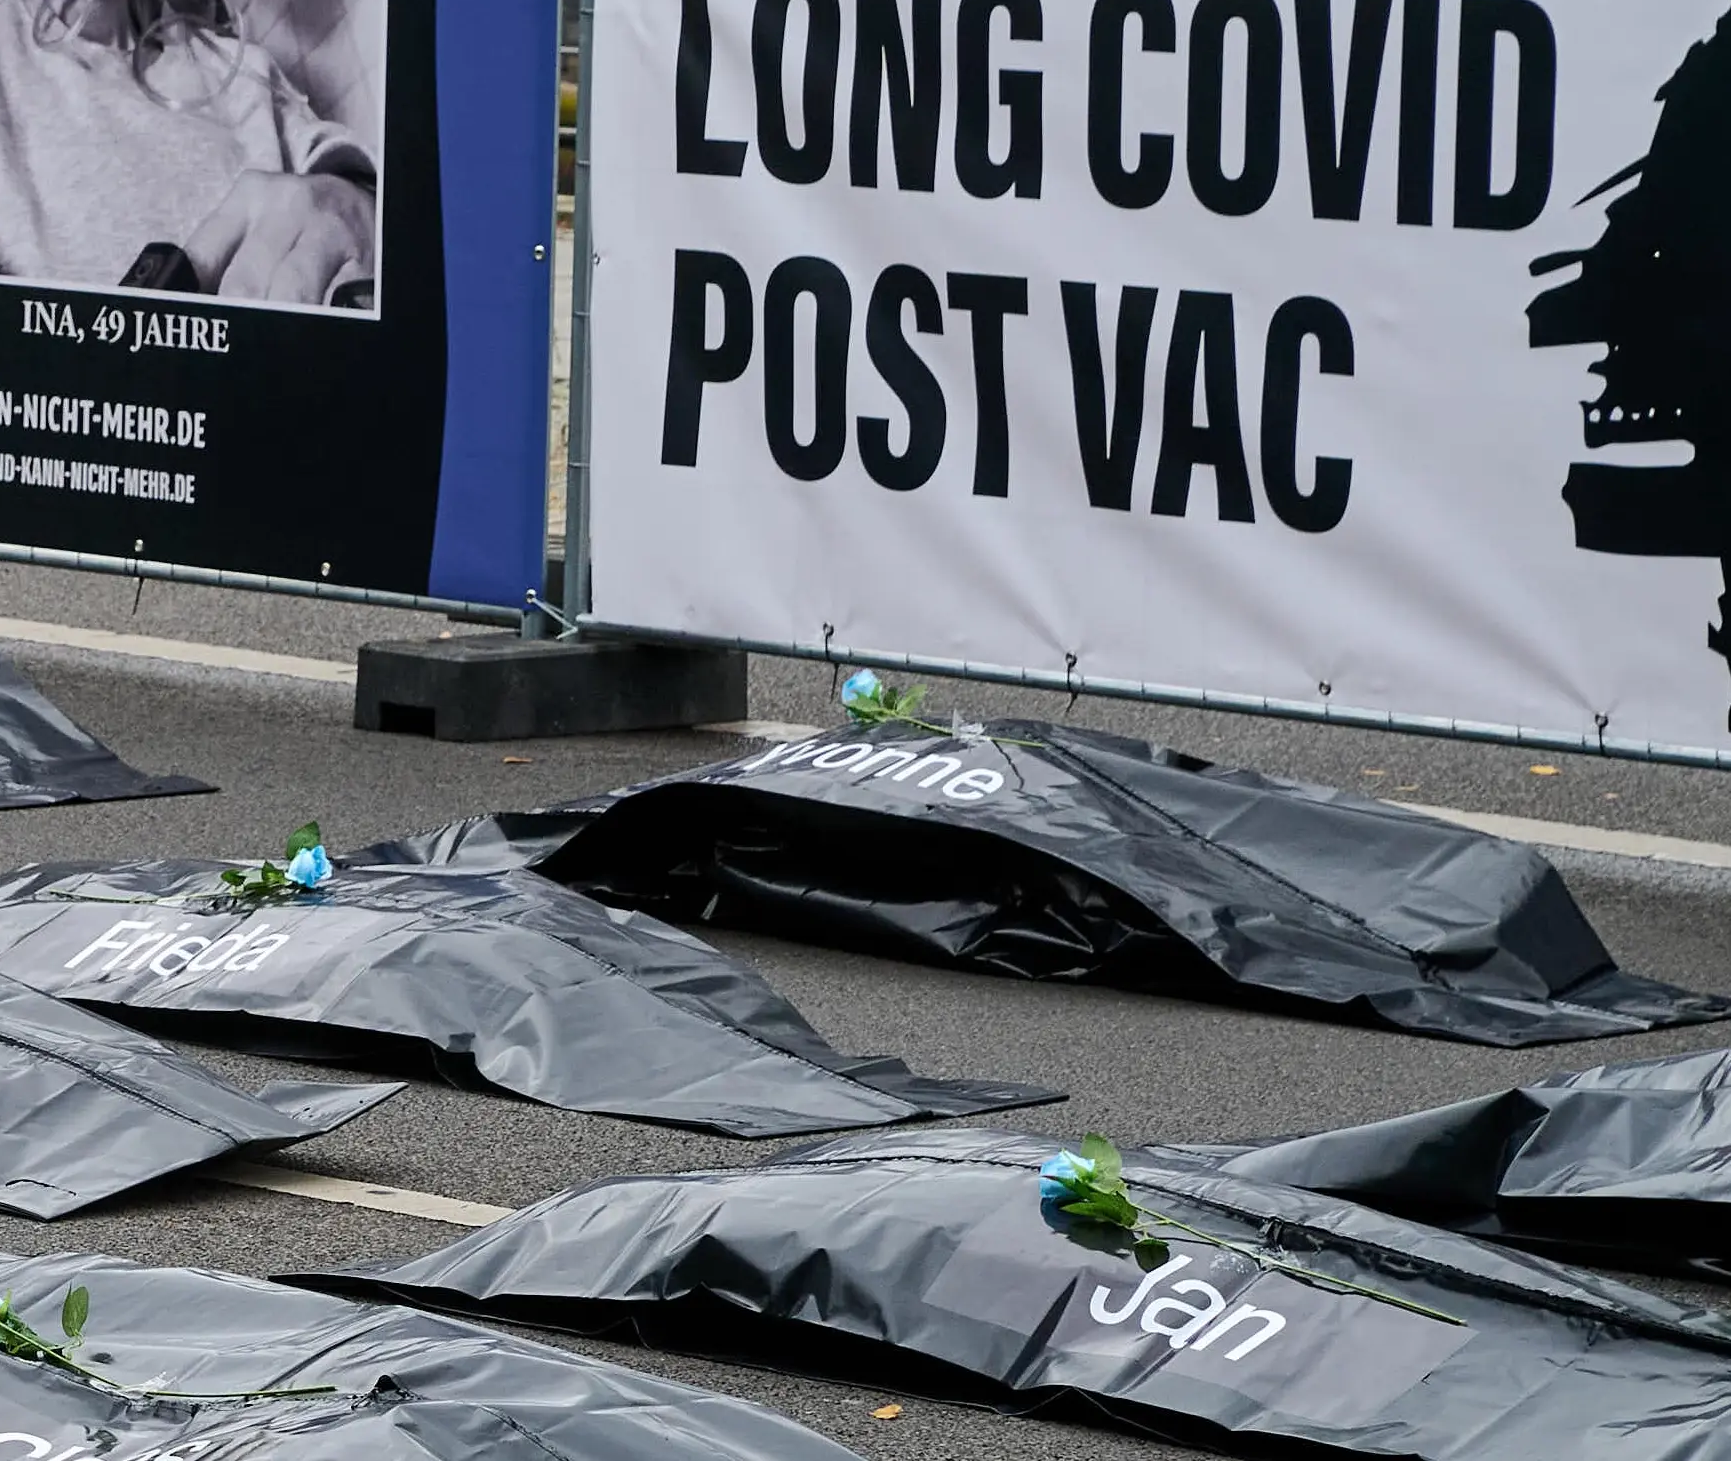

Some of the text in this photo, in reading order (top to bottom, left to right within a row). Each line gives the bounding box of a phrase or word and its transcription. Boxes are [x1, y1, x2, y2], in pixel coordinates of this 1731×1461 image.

[21, 300, 229, 354] INA, 49 JAHRE
[660, 248, 1357, 534] POST VAC
[64, 920, 290, 978] Frieda
[1089, 1254, 1287, 1361] Jan
